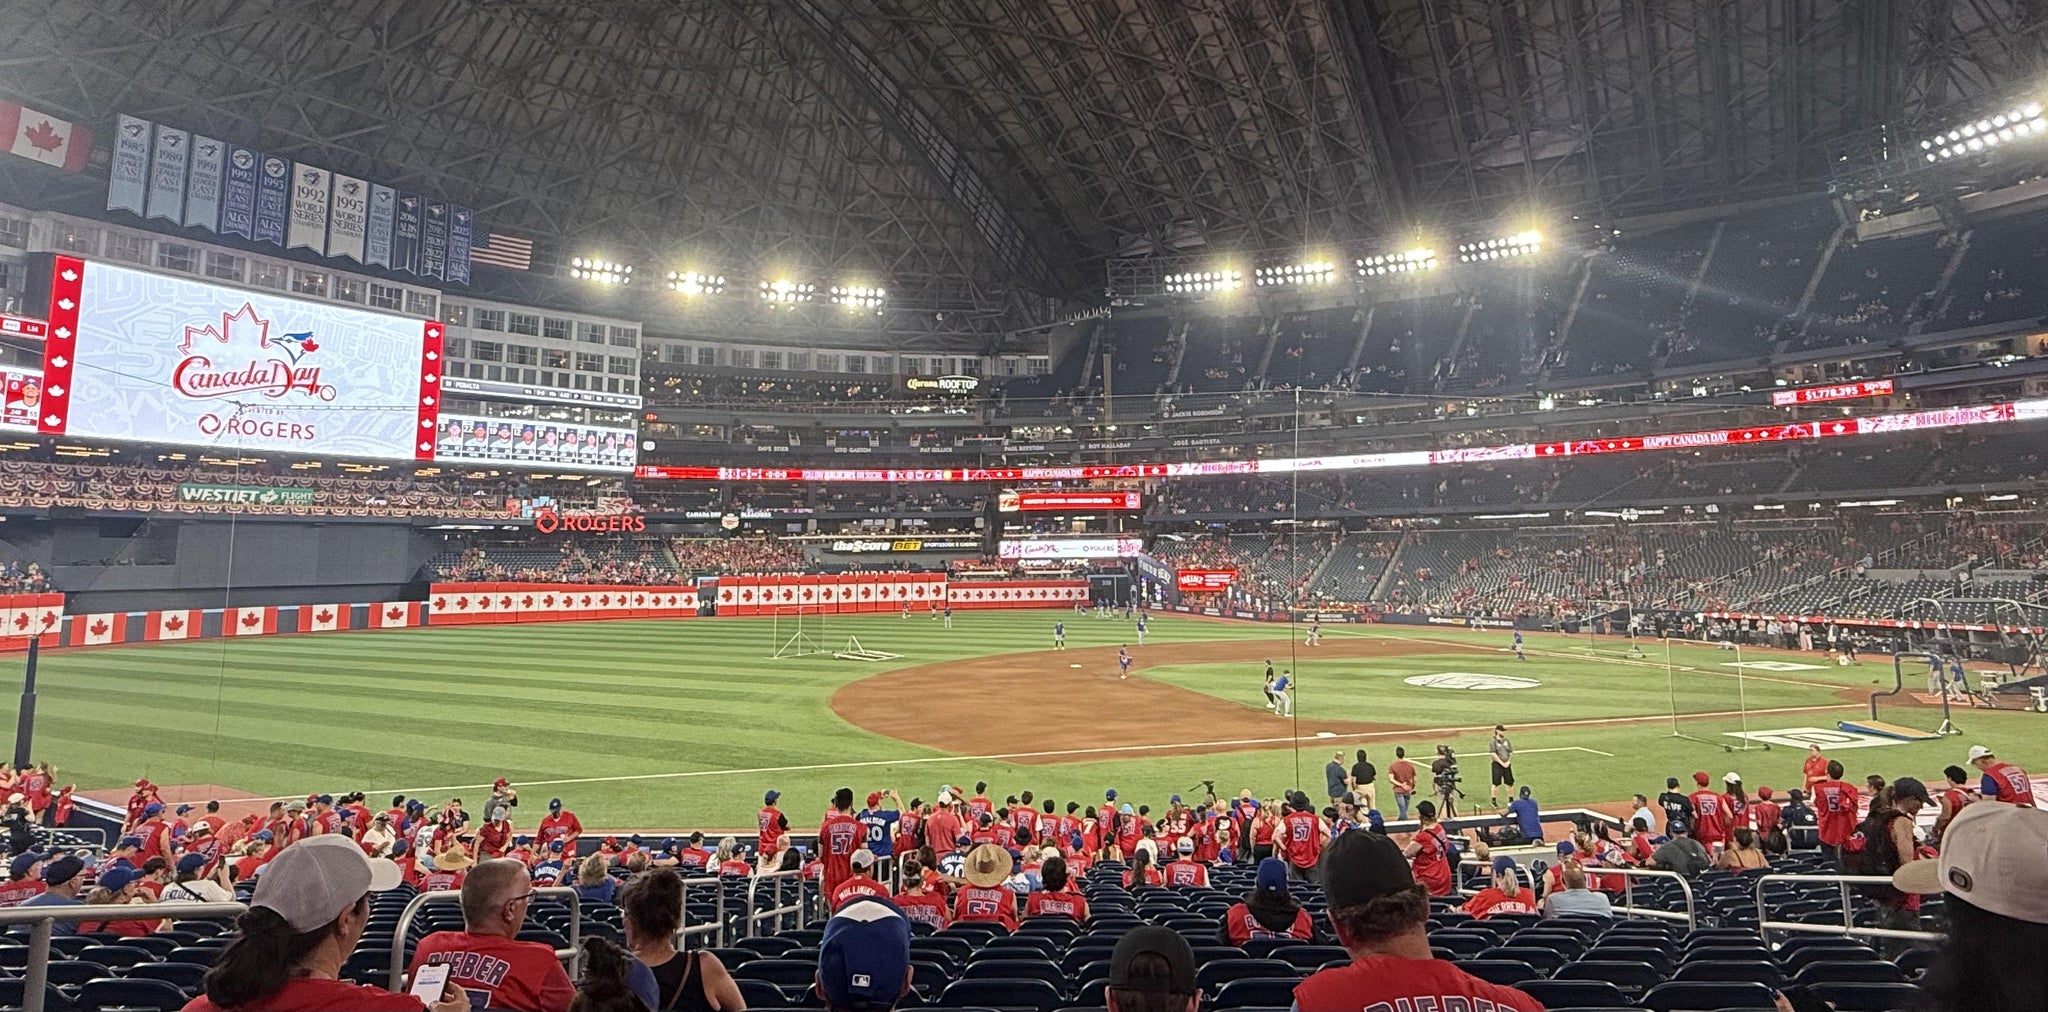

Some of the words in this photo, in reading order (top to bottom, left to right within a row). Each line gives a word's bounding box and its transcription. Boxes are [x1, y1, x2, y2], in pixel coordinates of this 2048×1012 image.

[120, 140, 144, 153] 1985
[160, 150, 182, 162] 1989
[197, 160, 217, 172] 1991
[232, 168, 252, 181] 1992
[296, 185, 324, 203] 1992
[295, 201, 324, 214] WORLD
[337, 196, 363, 213] 1993
[294, 211, 324, 224] SERIES
[335, 210, 363, 224] WORLD
[334, 219, 363, 232] SERIES
[174, 356, 269, 398] Canada
[266, 359, 321, 398] Day
[907, 379, 938, 390] Corona
[939, 380, 978, 389] ROOFTOP
[228, 418, 314, 440] ROGERS
[1643, 438, 1672, 449] HAPPY
[1673, 434, 1710, 446] CANADA
[1711, 432, 1728, 443] DAY
[1022, 470, 1045, 478] HAPPY
[1046, 469, 1070, 477] CANADA
[182, 488, 260, 502] WESTJET
[280, 492, 312, 500] FLIGHT
[564, 516, 645, 531] ROGERS
[833, 540, 890, 552] theScore
[1180, 575, 1204, 585] HEINZ
[2008, 775, 2027, 792] 57
[1701, 802, 1716, 814] 57
[1084, 823, 1094, 834] 7
[1294, 826, 1310, 841] 57
[832, 833, 852, 854] 57
[944, 864, 964, 878] 20
[1174, 873, 1194, 884] 57
[967, 888, 1002, 902] BIEBER
[968, 900, 998, 915] 57
[1041, 900, 1074, 915] BIEBER
